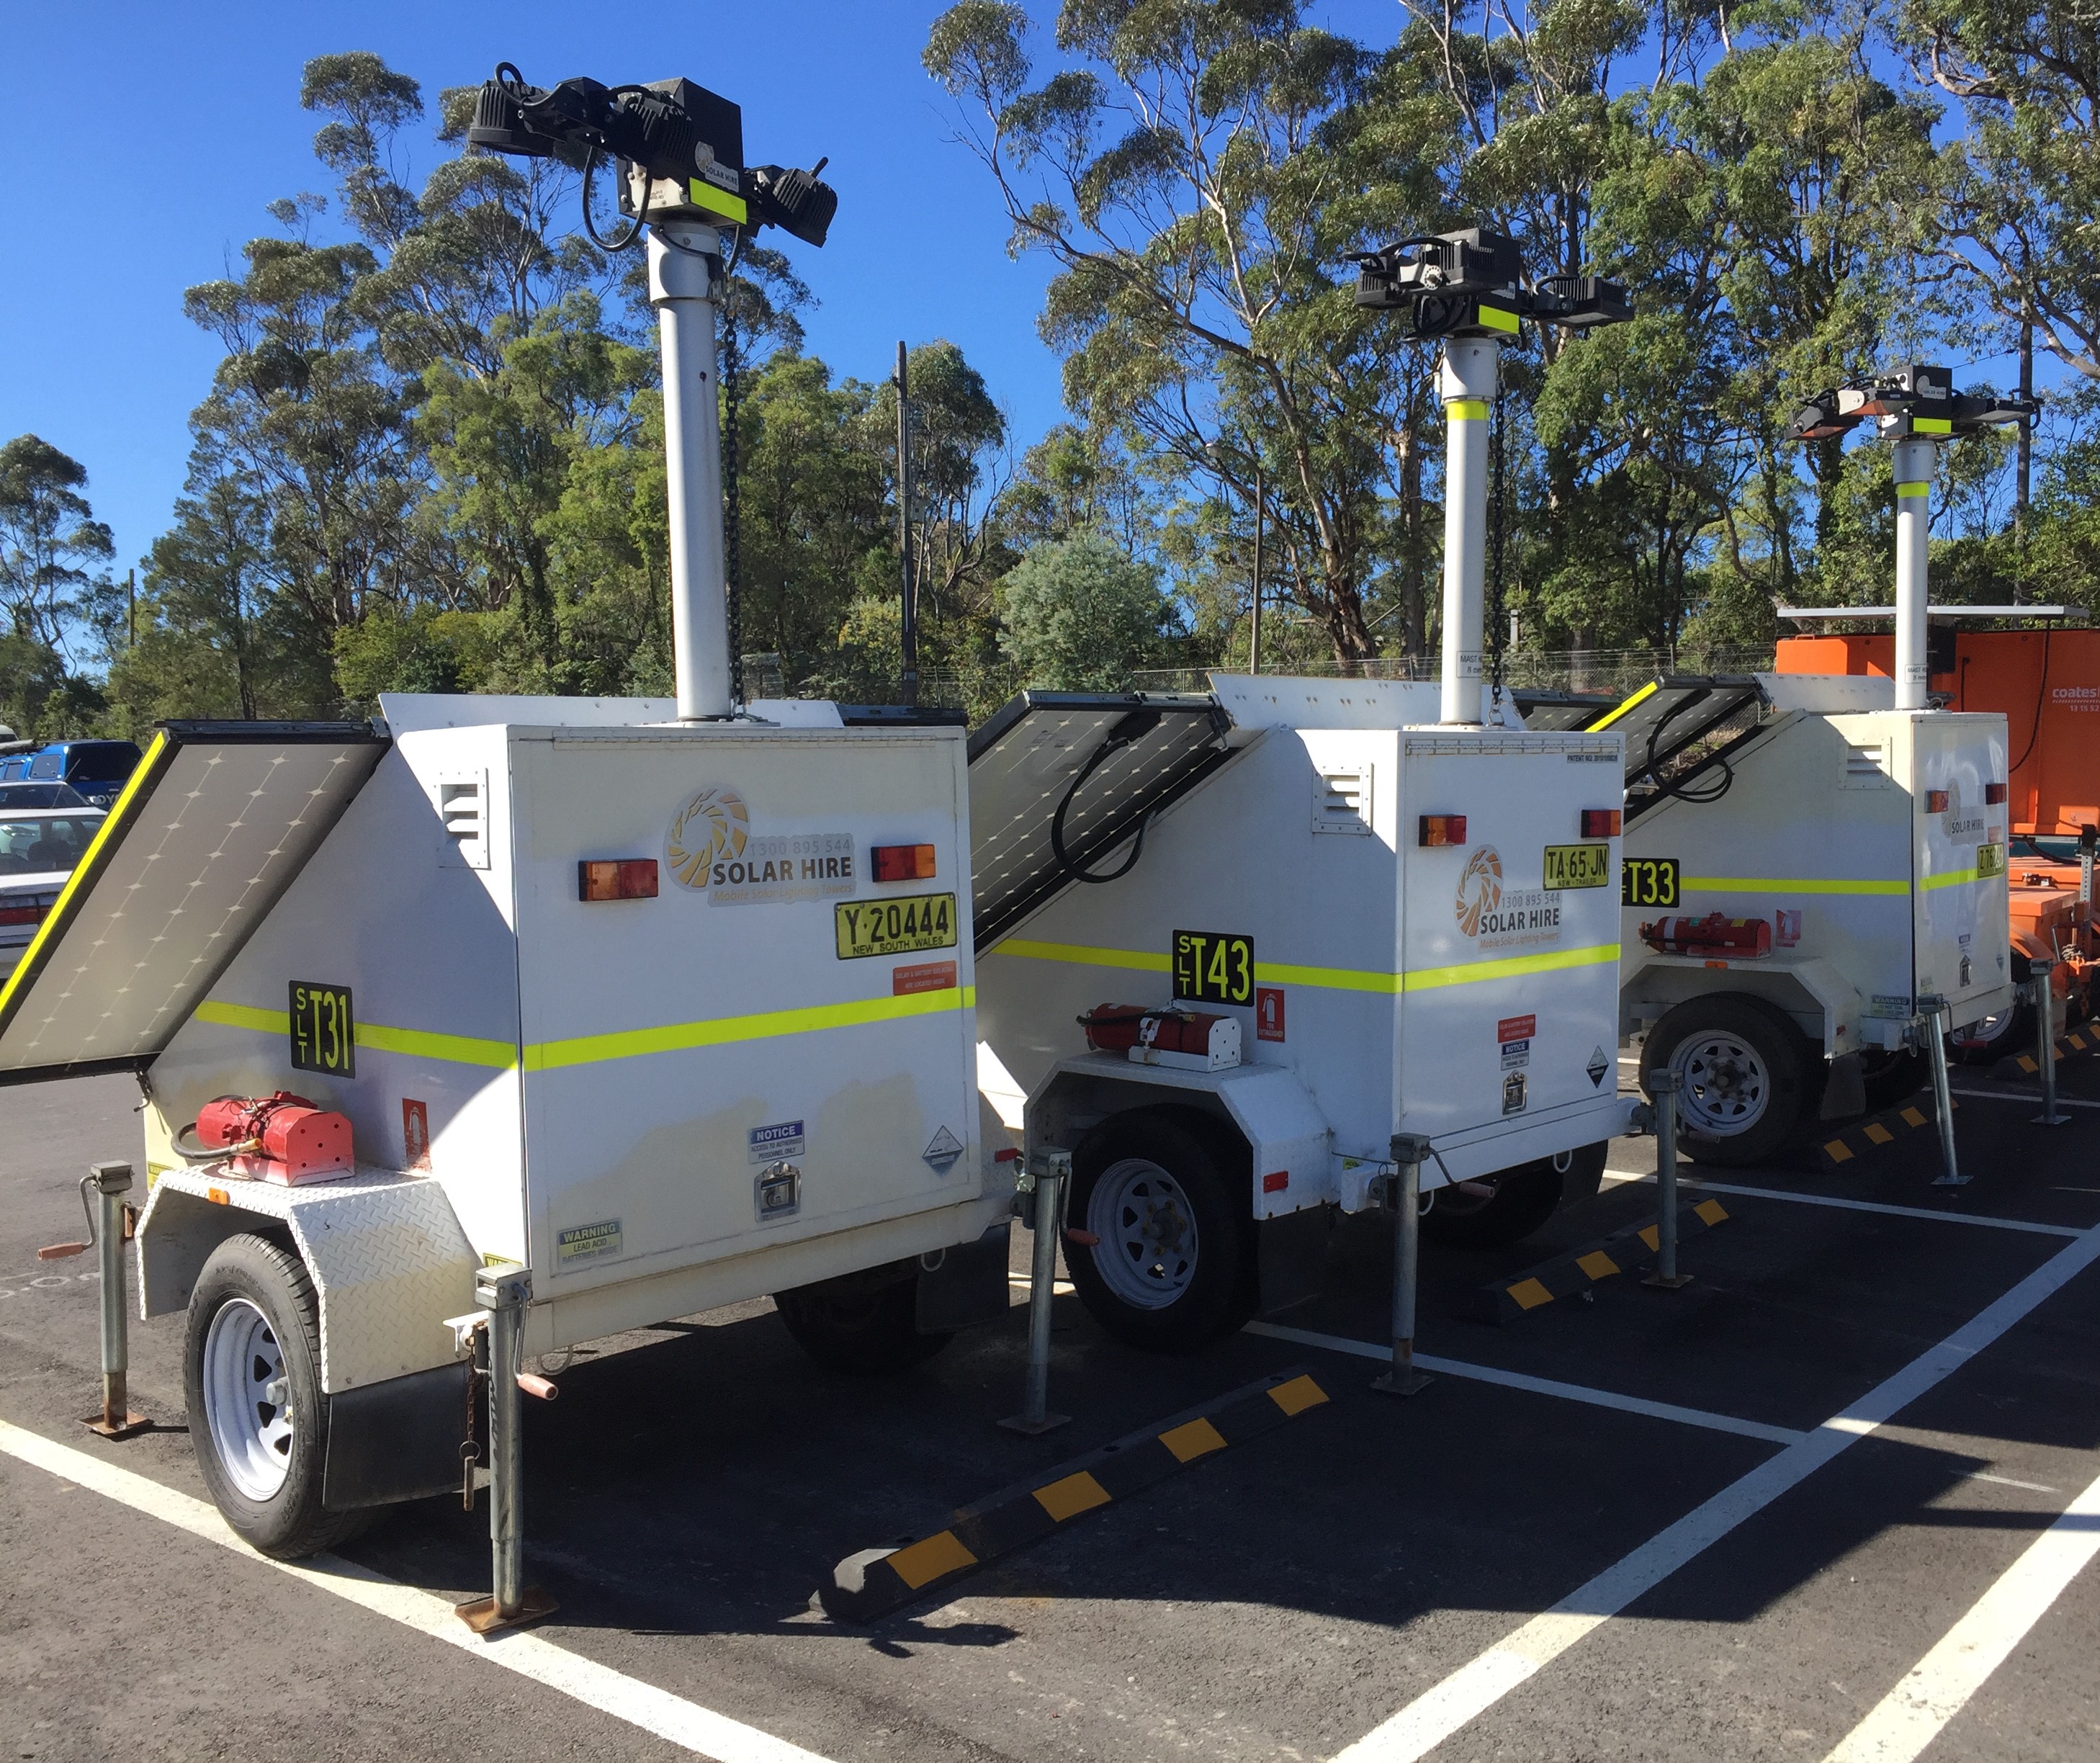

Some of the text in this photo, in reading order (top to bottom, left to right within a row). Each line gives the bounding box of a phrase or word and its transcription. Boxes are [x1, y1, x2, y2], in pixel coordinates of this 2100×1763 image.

[705, 165, 738, 186] SOLAR HIRE
[1952, 818, 1985, 834] SOLAR HIRE
[750, 839, 851, 856] 1300 895 544
[713, 856, 853, 886] SOLAR HIRE
[713, 890, 750, 901] Mobile
[822, 883, 853, 894] Towers
[1628, 861, 1674, 905] T33
[1501, 892, 1560, 909] 1300 895 544
[1480, 907, 1560, 935] SOLAR HIRE
[852, 936, 944, 956] NEW SOUTH WALES
[1480, 937, 1499, 948] Mobile
[1190, 936, 1250, 1002] T43
[1873, 997, 1908, 1005] WARNING
[309, 990, 349, 1070] T31
[1505, 1042, 1526, 1053] NOTICE
[756, 1125, 796, 1141] NOTICE
[563, 1223, 616, 1243] WARNING
[573, 1238, 607, 1252] LEAD ACID
